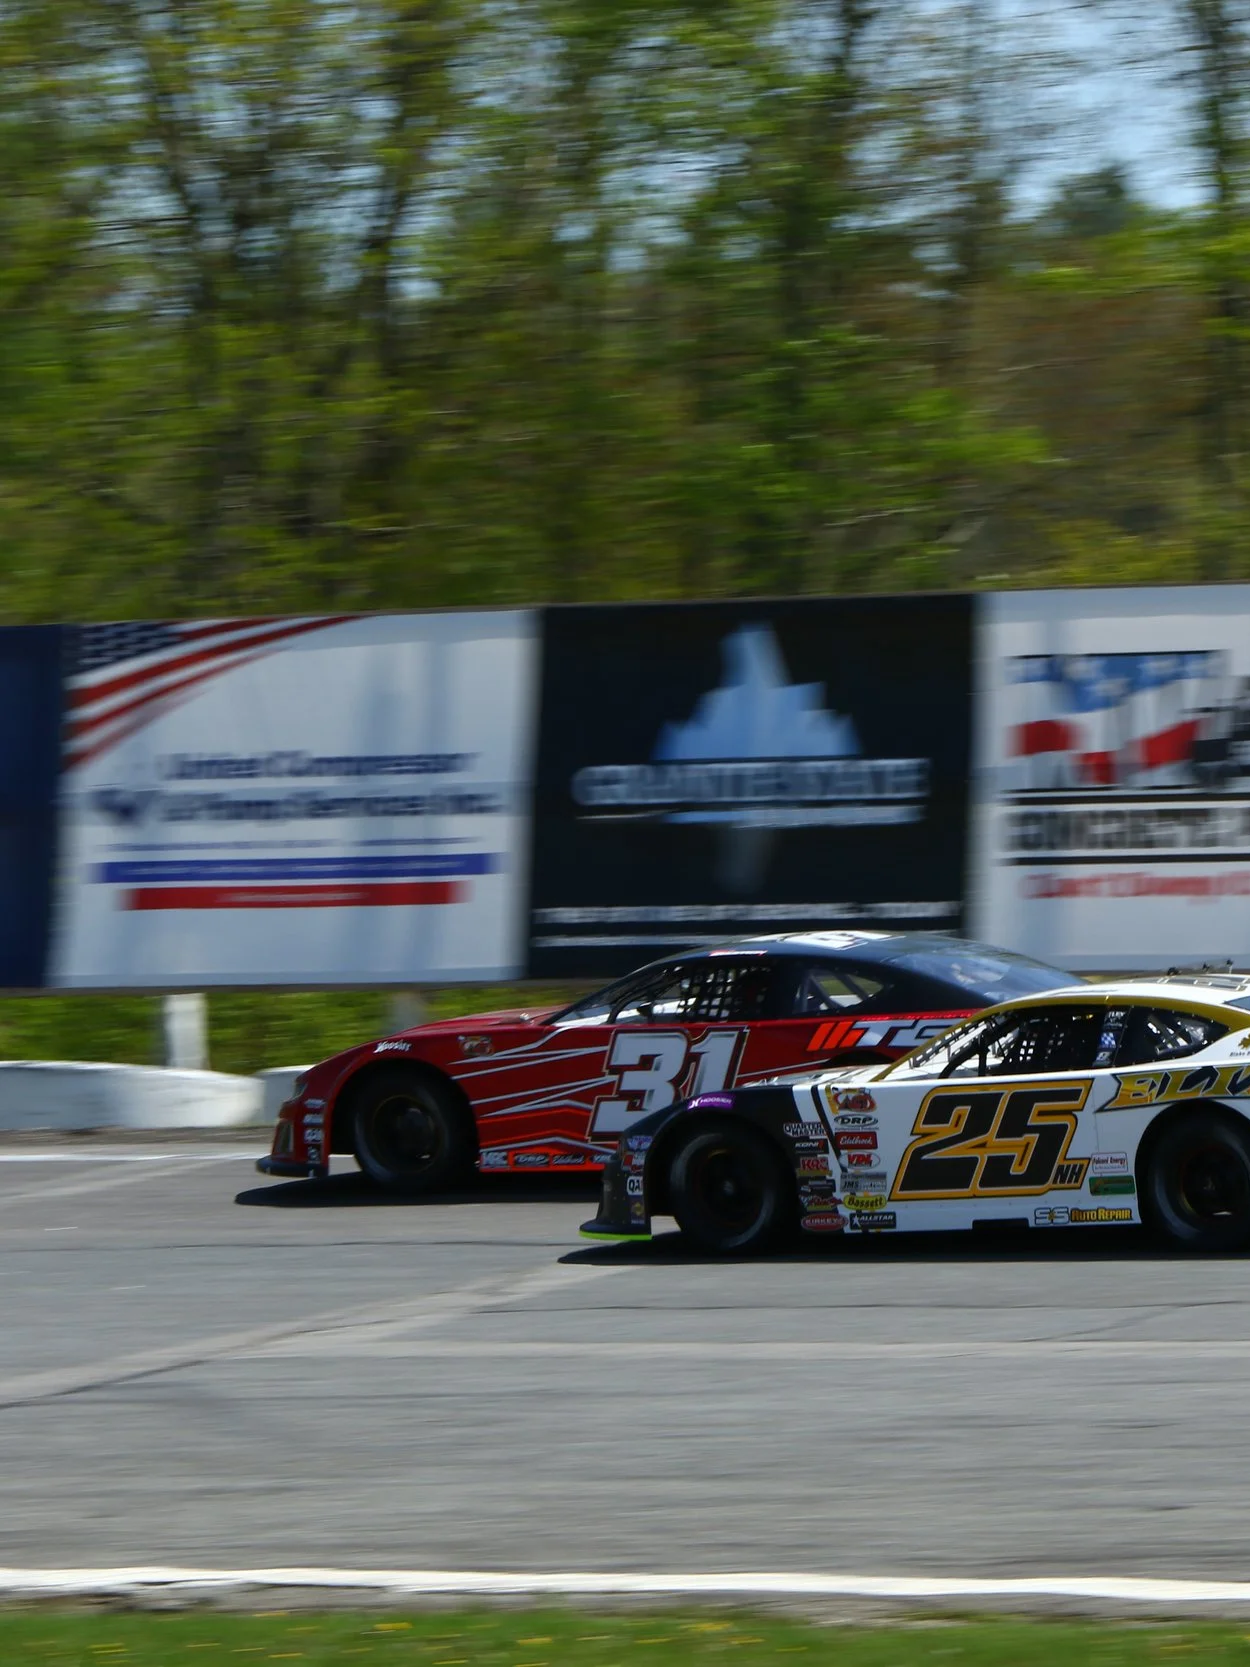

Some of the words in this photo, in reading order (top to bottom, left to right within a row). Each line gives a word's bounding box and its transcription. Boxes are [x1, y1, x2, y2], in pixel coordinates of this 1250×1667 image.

[586, 1026, 750, 1144] 31
[839, 1116, 873, 1125] DRP
[888, 1079, 1094, 1200] 25
[1052, 1163, 1085, 1184] NH
[859, 1213, 894, 1221] ALLSTAR
